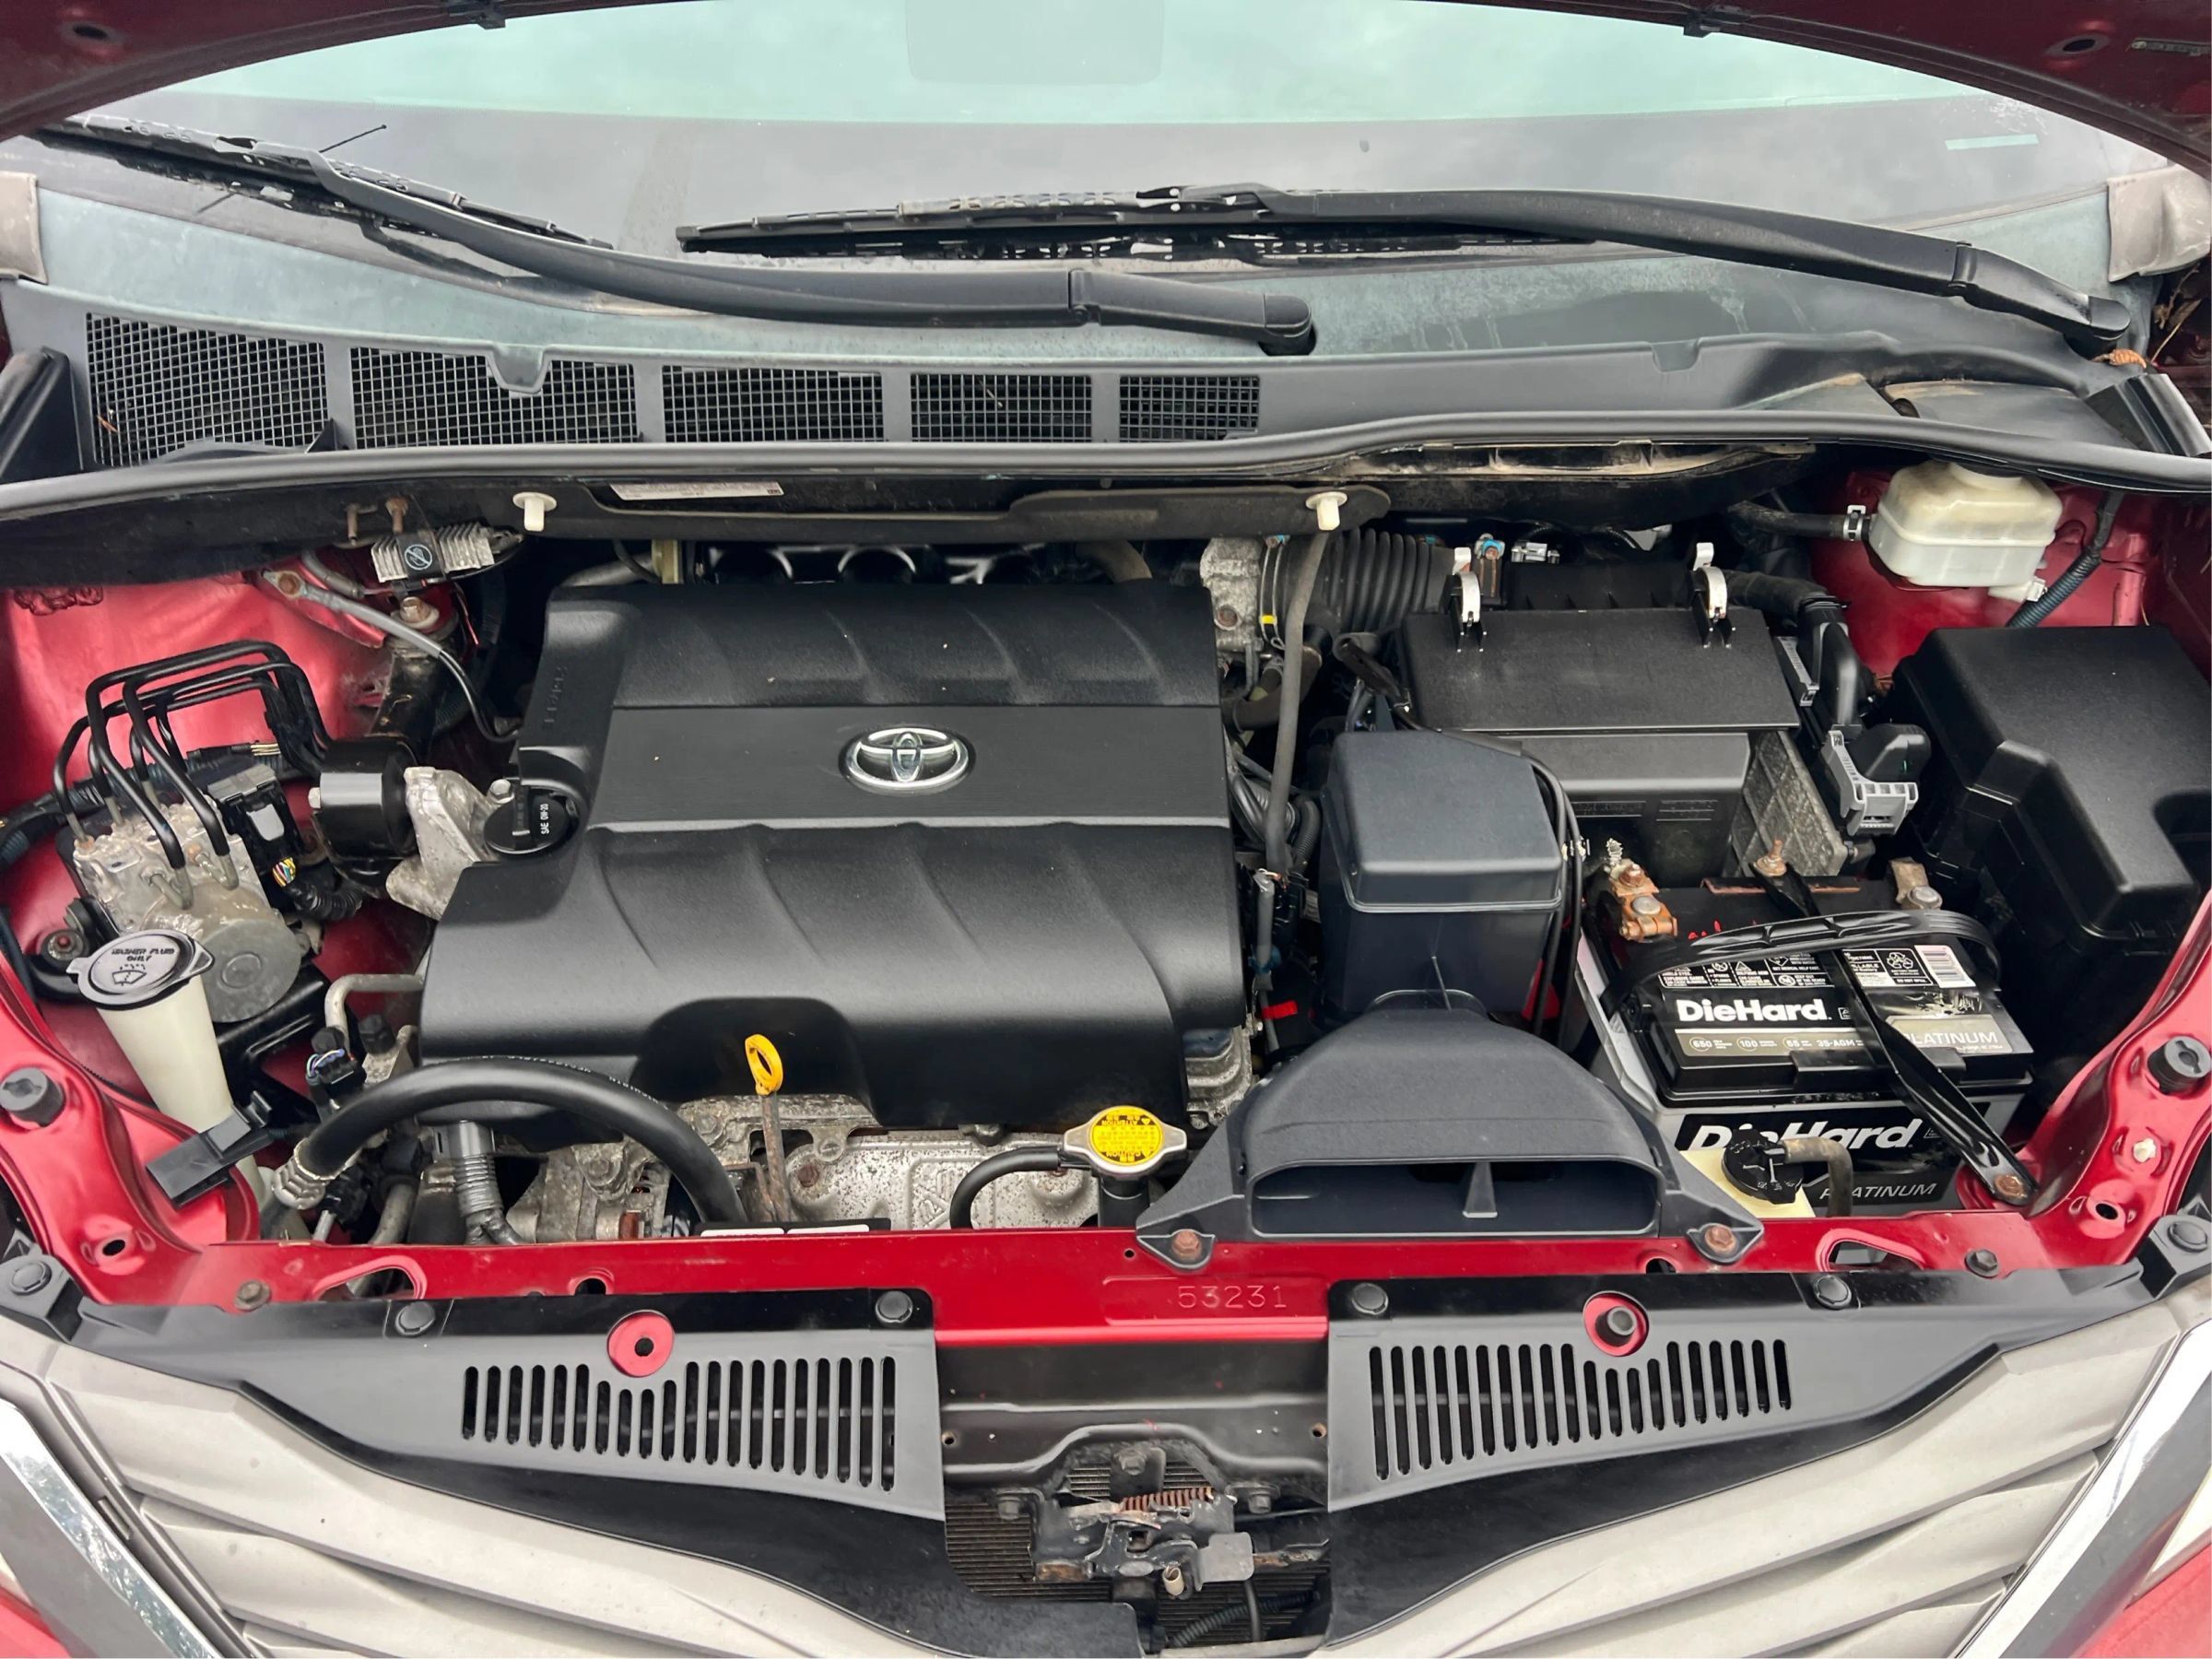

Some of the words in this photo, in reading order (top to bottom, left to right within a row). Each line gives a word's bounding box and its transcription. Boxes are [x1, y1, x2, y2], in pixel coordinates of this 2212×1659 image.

[540, 822, 550, 835] SAE
[1739, 1039, 1758, 1048] 100
[1819, 1182, 1938, 1200] PATINUM
[1177, 1284, 1288, 1309] 53231
